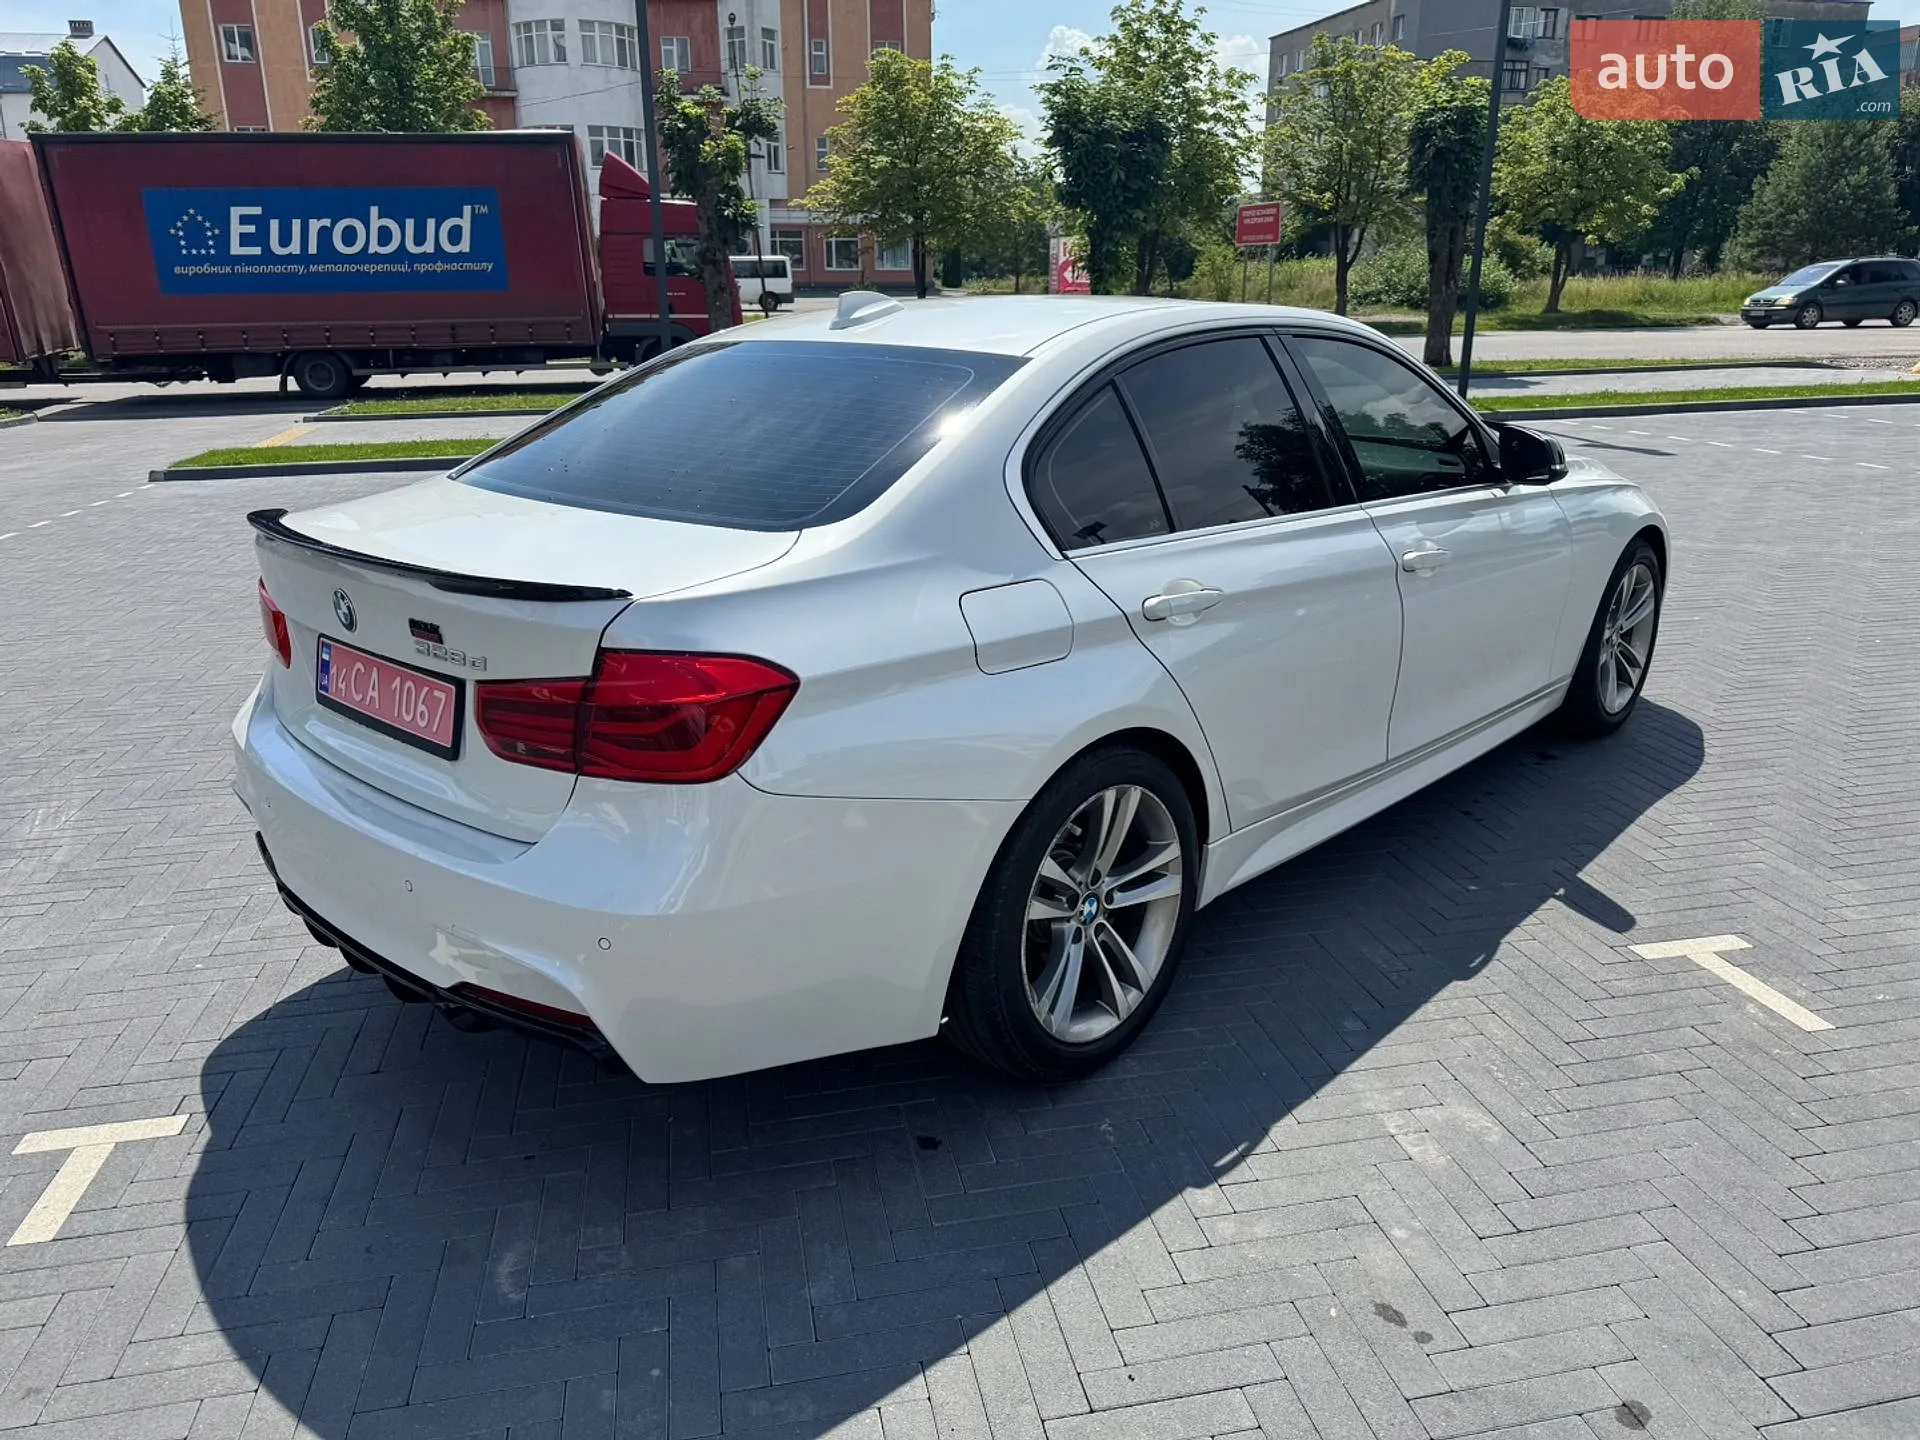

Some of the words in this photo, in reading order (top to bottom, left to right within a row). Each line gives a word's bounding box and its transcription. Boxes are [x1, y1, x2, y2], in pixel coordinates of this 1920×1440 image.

[229, 205, 472, 255] Eurobud
[174, 262, 232, 276] виробник
[413, 260, 494, 273] профнастилу
